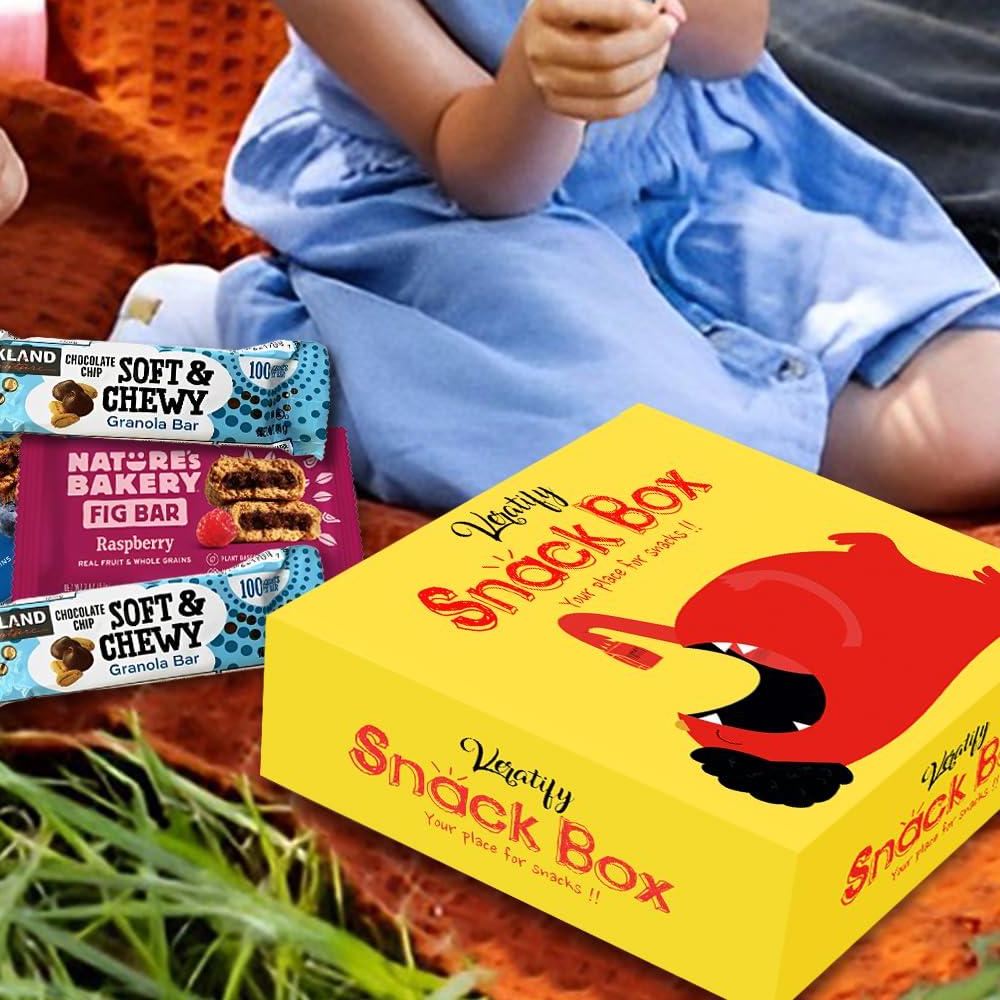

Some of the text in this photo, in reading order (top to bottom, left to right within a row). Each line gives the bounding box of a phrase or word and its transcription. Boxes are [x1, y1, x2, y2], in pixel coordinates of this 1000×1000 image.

[65, 354, 115, 367] CHOCOLATE
[81, 366, 102, 378] CHIP
[118, 357, 214, 386] SOFT &
[249, 361, 271, 379] 100
[103, 386, 209, 416] CHEWY
[106, 415, 199, 431] Granola Bar
[67, 472, 201, 496] BAKERY
[90, 503, 180, 524] FIG BAR
[451, 485, 569, 543] Veratify
[96, 535, 174, 554] Raspberry
[417, 469, 713, 632] Snack Box
[101, 559, 124, 567] FRUIT
[126, 558, 132, 566] &
[559, 588, 597, 608] Your
[592, 566, 627, 593] place
[616, 555, 644, 571] for
[645, 530, 689, 558] snacks
[240, 577, 263, 599] 100
[55, 604, 106, 622] CHOCOLATE
[109, 589, 207, 630] SOFT &
[73, 619, 95, 632] CHIP
[99, 620, 204, 662] CHEWY
[109, 654, 200, 677] Granola Bar
[459, 736, 576, 814] Veratify
[349, 724, 675, 914] Snack Box
[840, 773, 967, 906] Snack
[424, 811, 457, 836] Your
[462, 829, 499, 854] place
[503, 848, 527, 868] for
[532, 863, 582, 896] snacks
